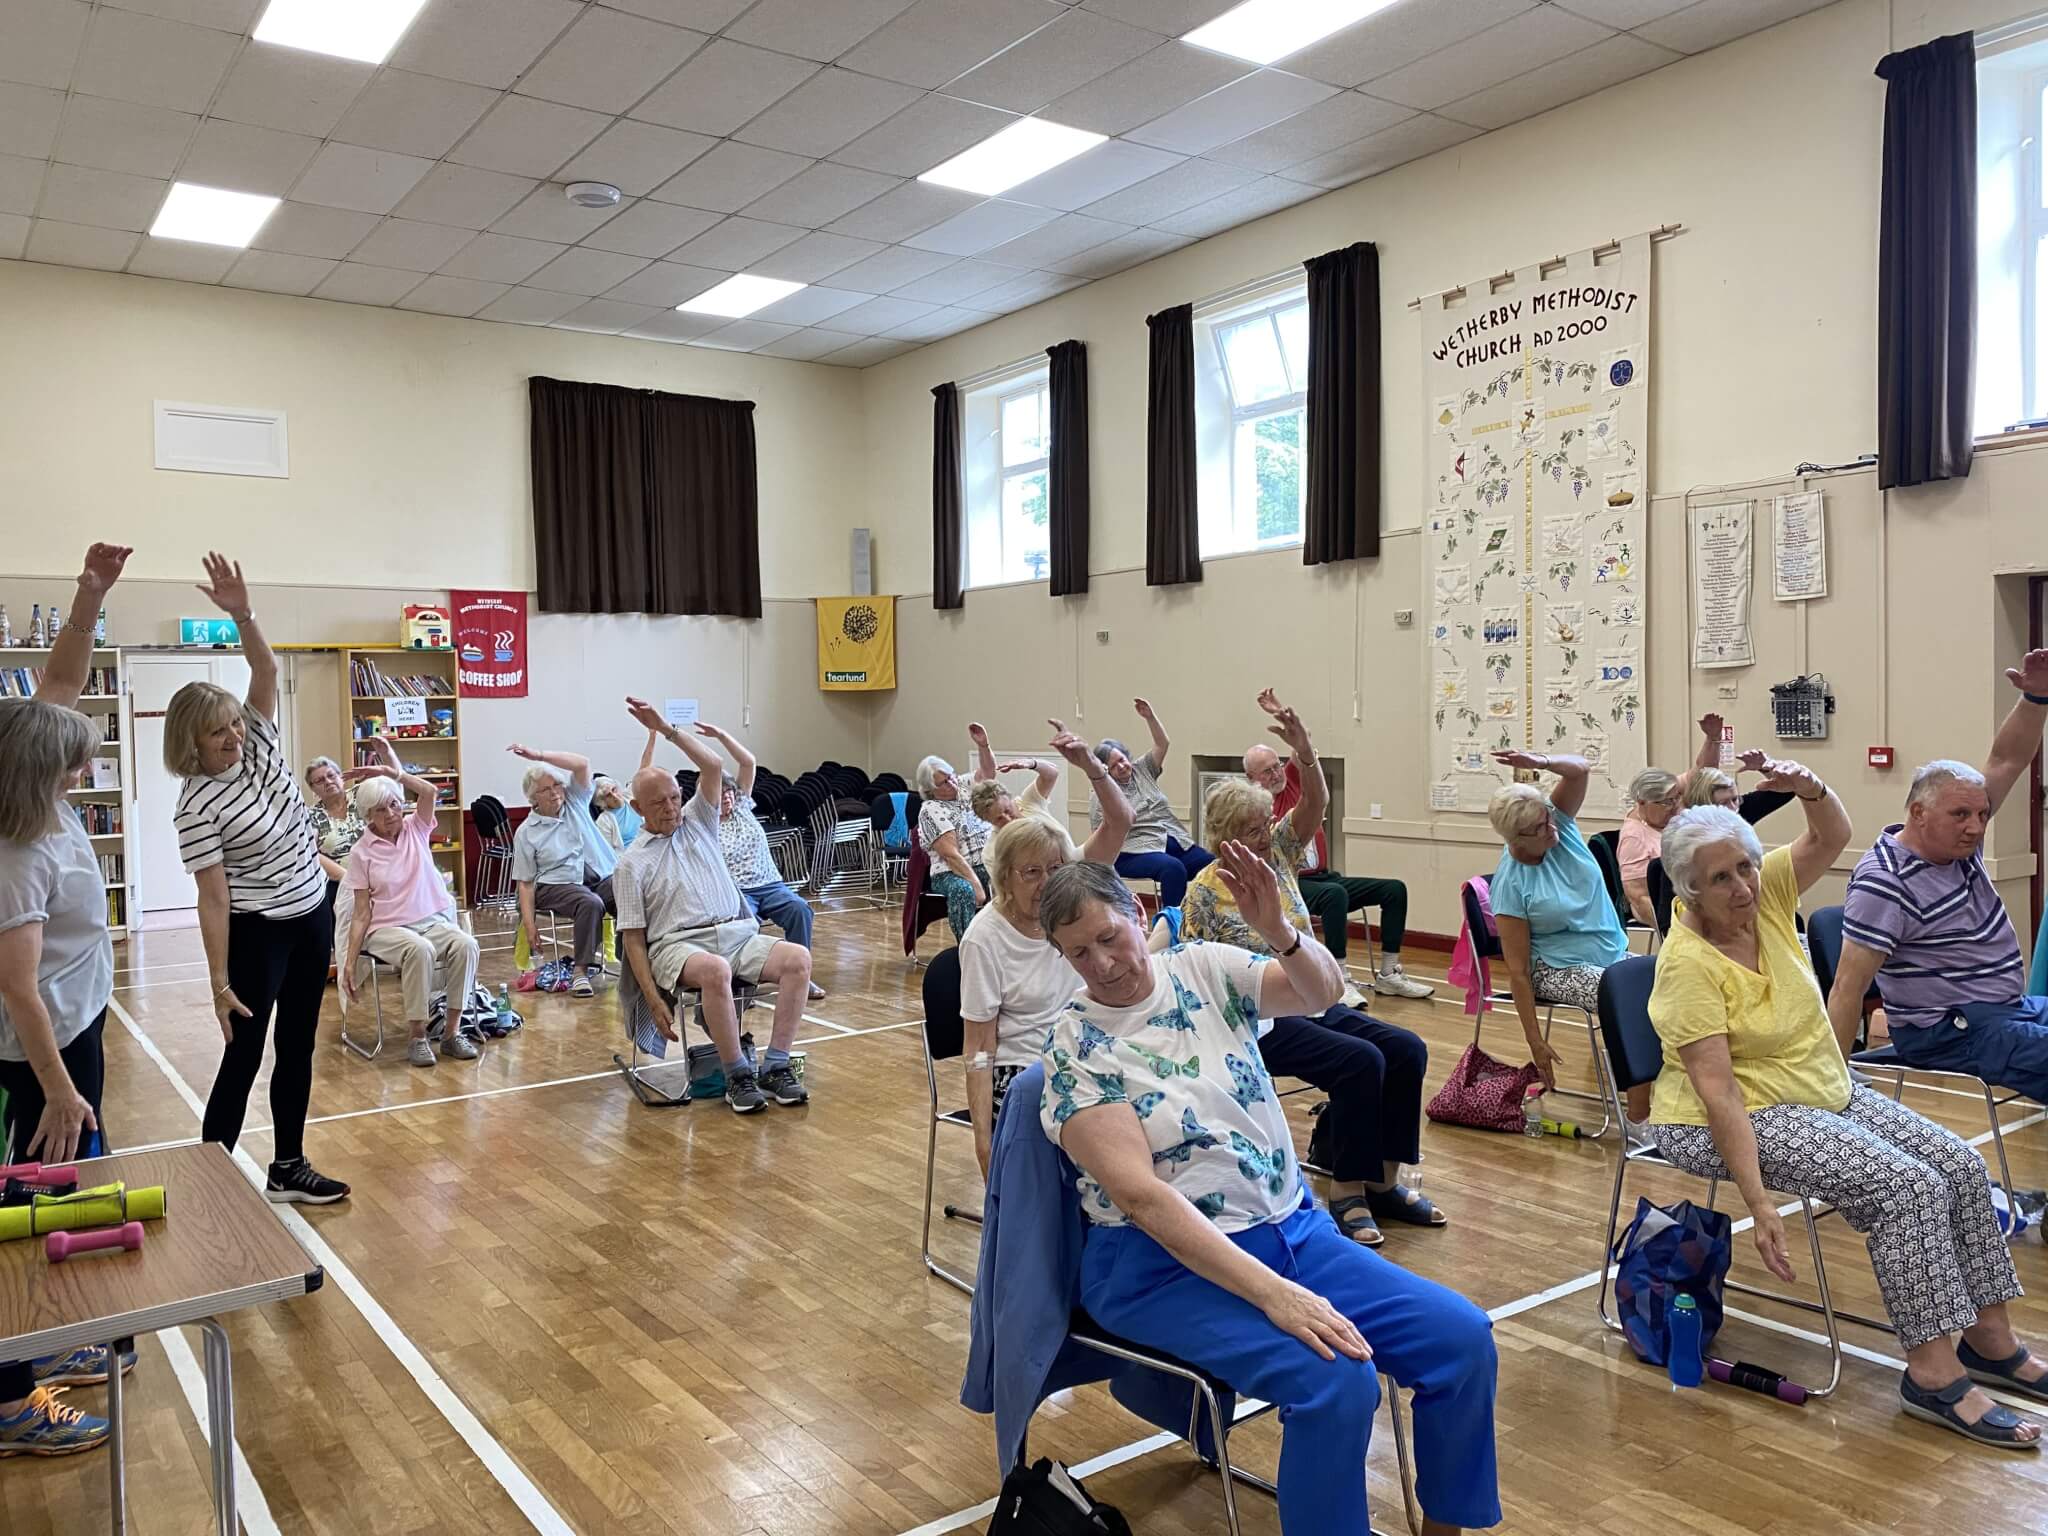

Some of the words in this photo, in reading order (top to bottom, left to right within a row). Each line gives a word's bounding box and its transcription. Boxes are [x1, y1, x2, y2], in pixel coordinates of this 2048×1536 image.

[1432, 300, 1522, 361] WETHERBY
[1533, 287, 1638, 314] METHODIST
[1456, 333, 1522, 369] CHURCH
[1534, 331, 1553, 348] AD
[1557, 315, 1607, 342] 2000
[459, 668, 495, 687] COFFEE
[496, 669, 522, 687] SHOP
[827, 671, 865, 682] tearfund
